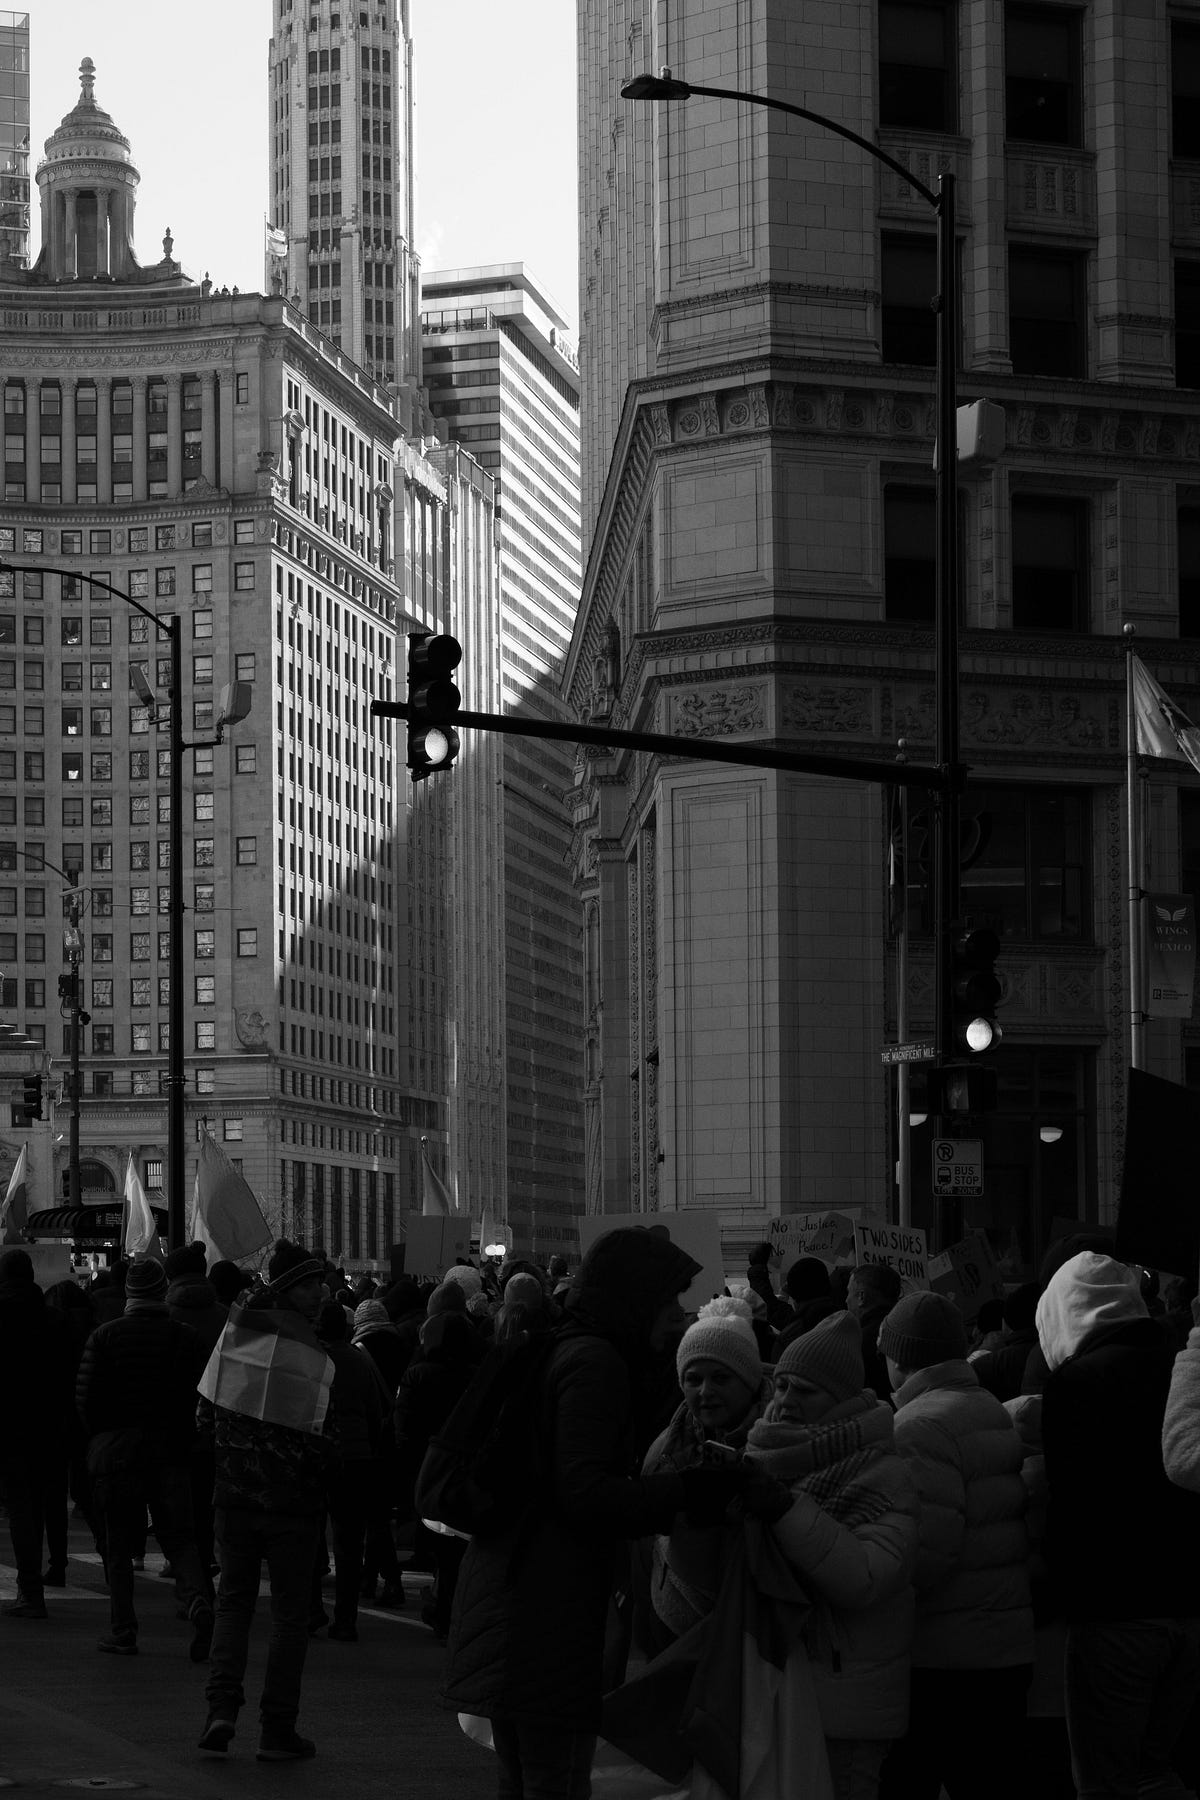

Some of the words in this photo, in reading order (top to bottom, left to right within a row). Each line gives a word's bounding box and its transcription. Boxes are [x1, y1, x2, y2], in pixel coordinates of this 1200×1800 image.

[1154, 926, 1189, 935] WINGS
[881, 1052, 891, 1063] THE
[891, 1049, 922, 1061] MAGNIFICENT
[923, 1047, 935, 1058] MILE
[954, 1166, 974, 1175] BUS
[954, 1176, 979, 1185] STOP
[770, 1219, 788, 1234] No
[858, 1226, 888, 1251] TWO
[891, 1231, 922, 1255] SIDES
[770, 1245, 786, 1257] No
[898, 1257, 925, 1279] COIN
